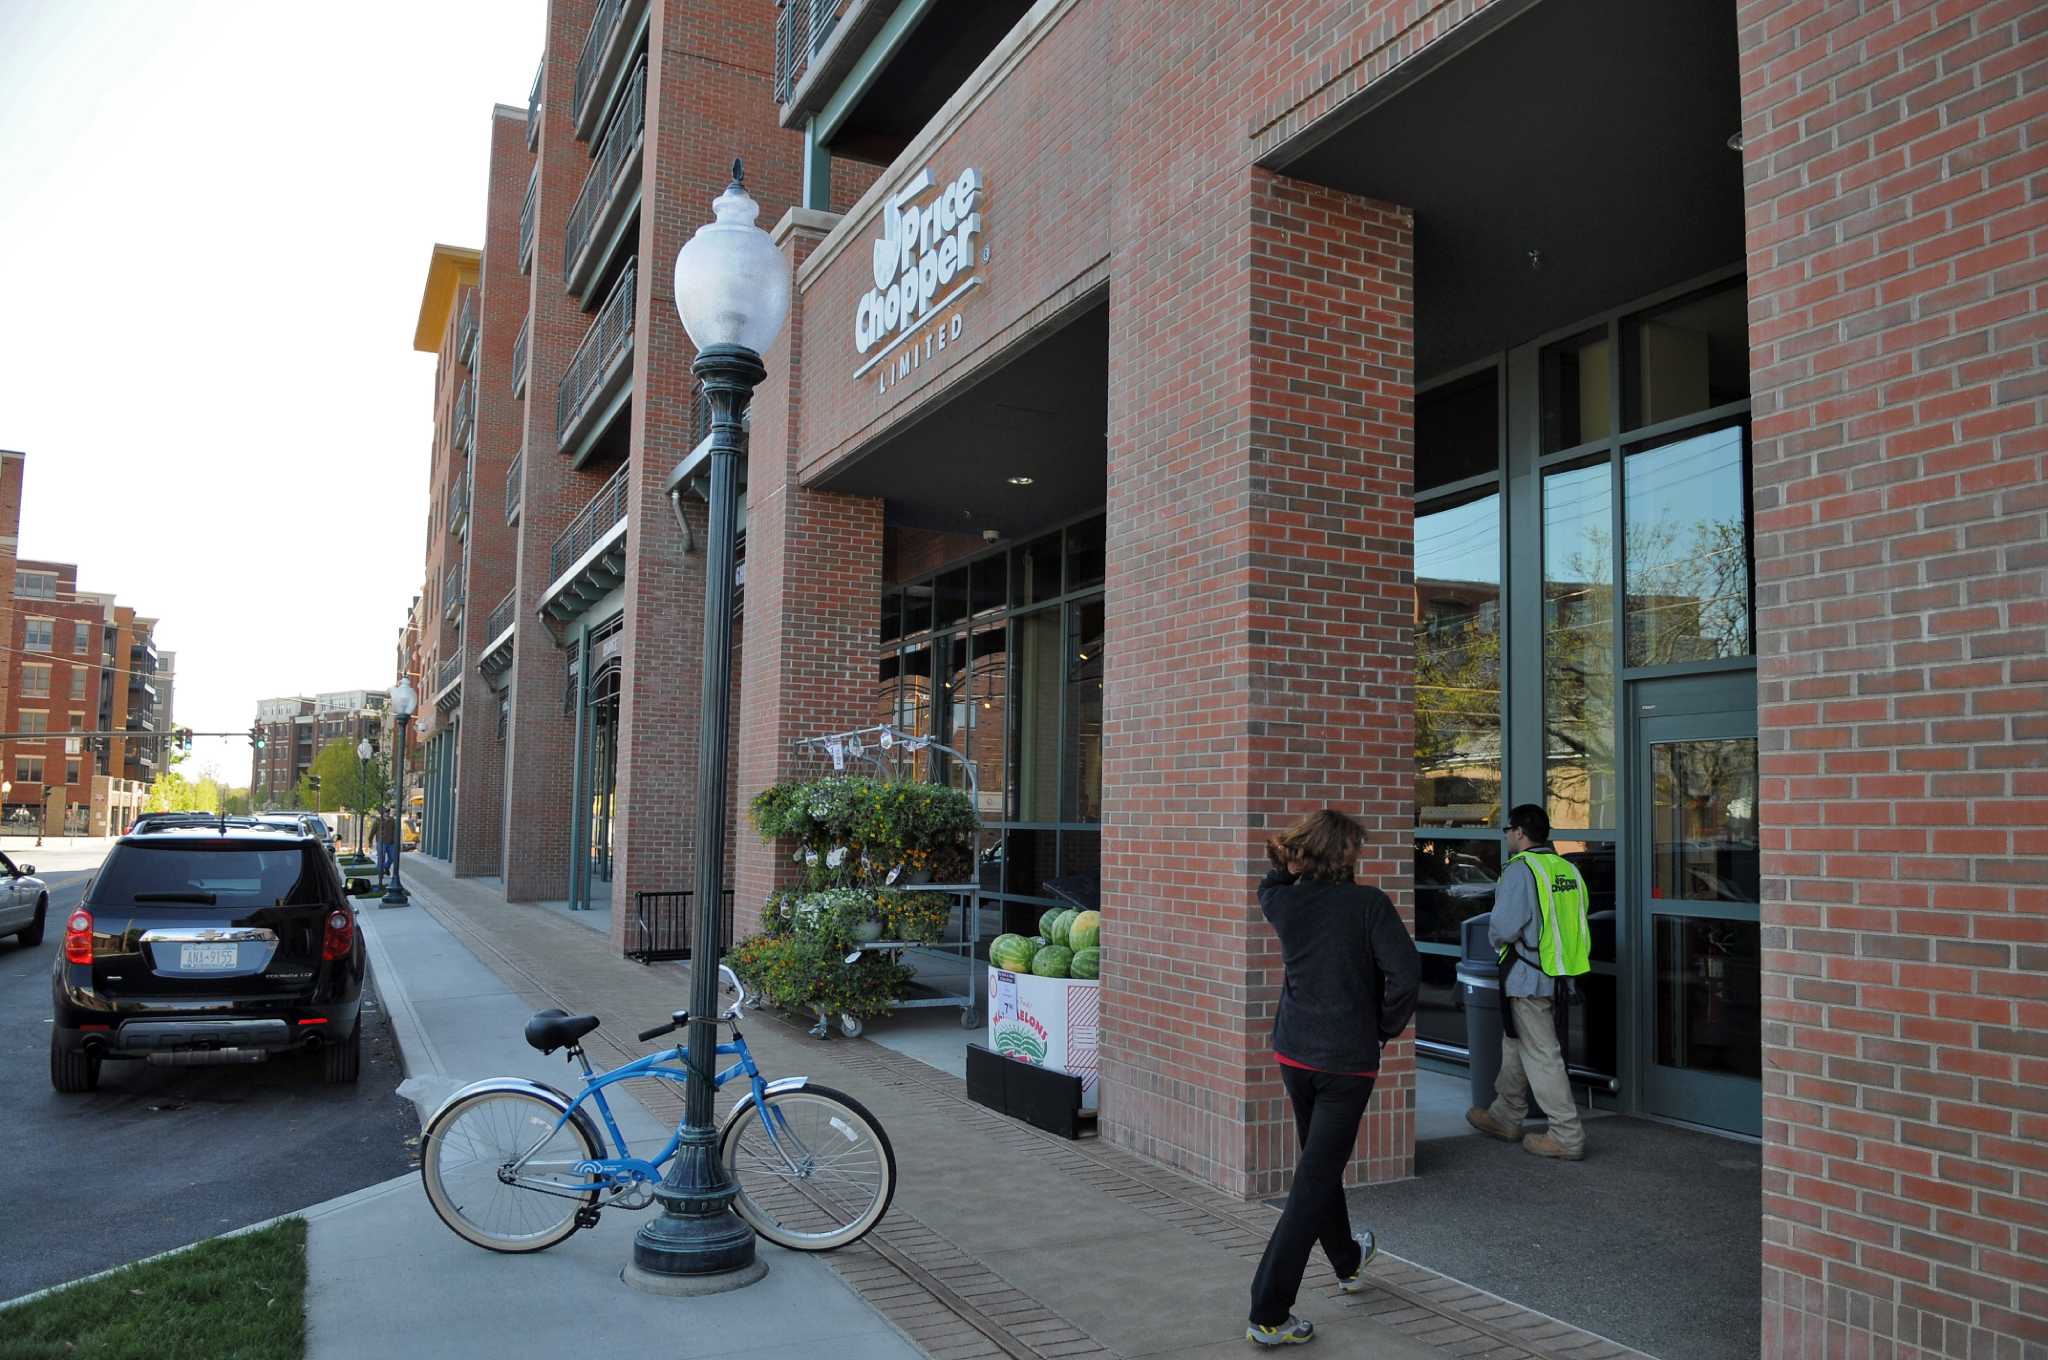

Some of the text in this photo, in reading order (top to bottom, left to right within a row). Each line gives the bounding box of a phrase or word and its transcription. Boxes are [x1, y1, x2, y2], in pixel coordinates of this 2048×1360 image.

[901, 167, 981, 273] Price
[855, 213, 980, 353] Chopper
[879, 313, 963, 395] LIMITED
